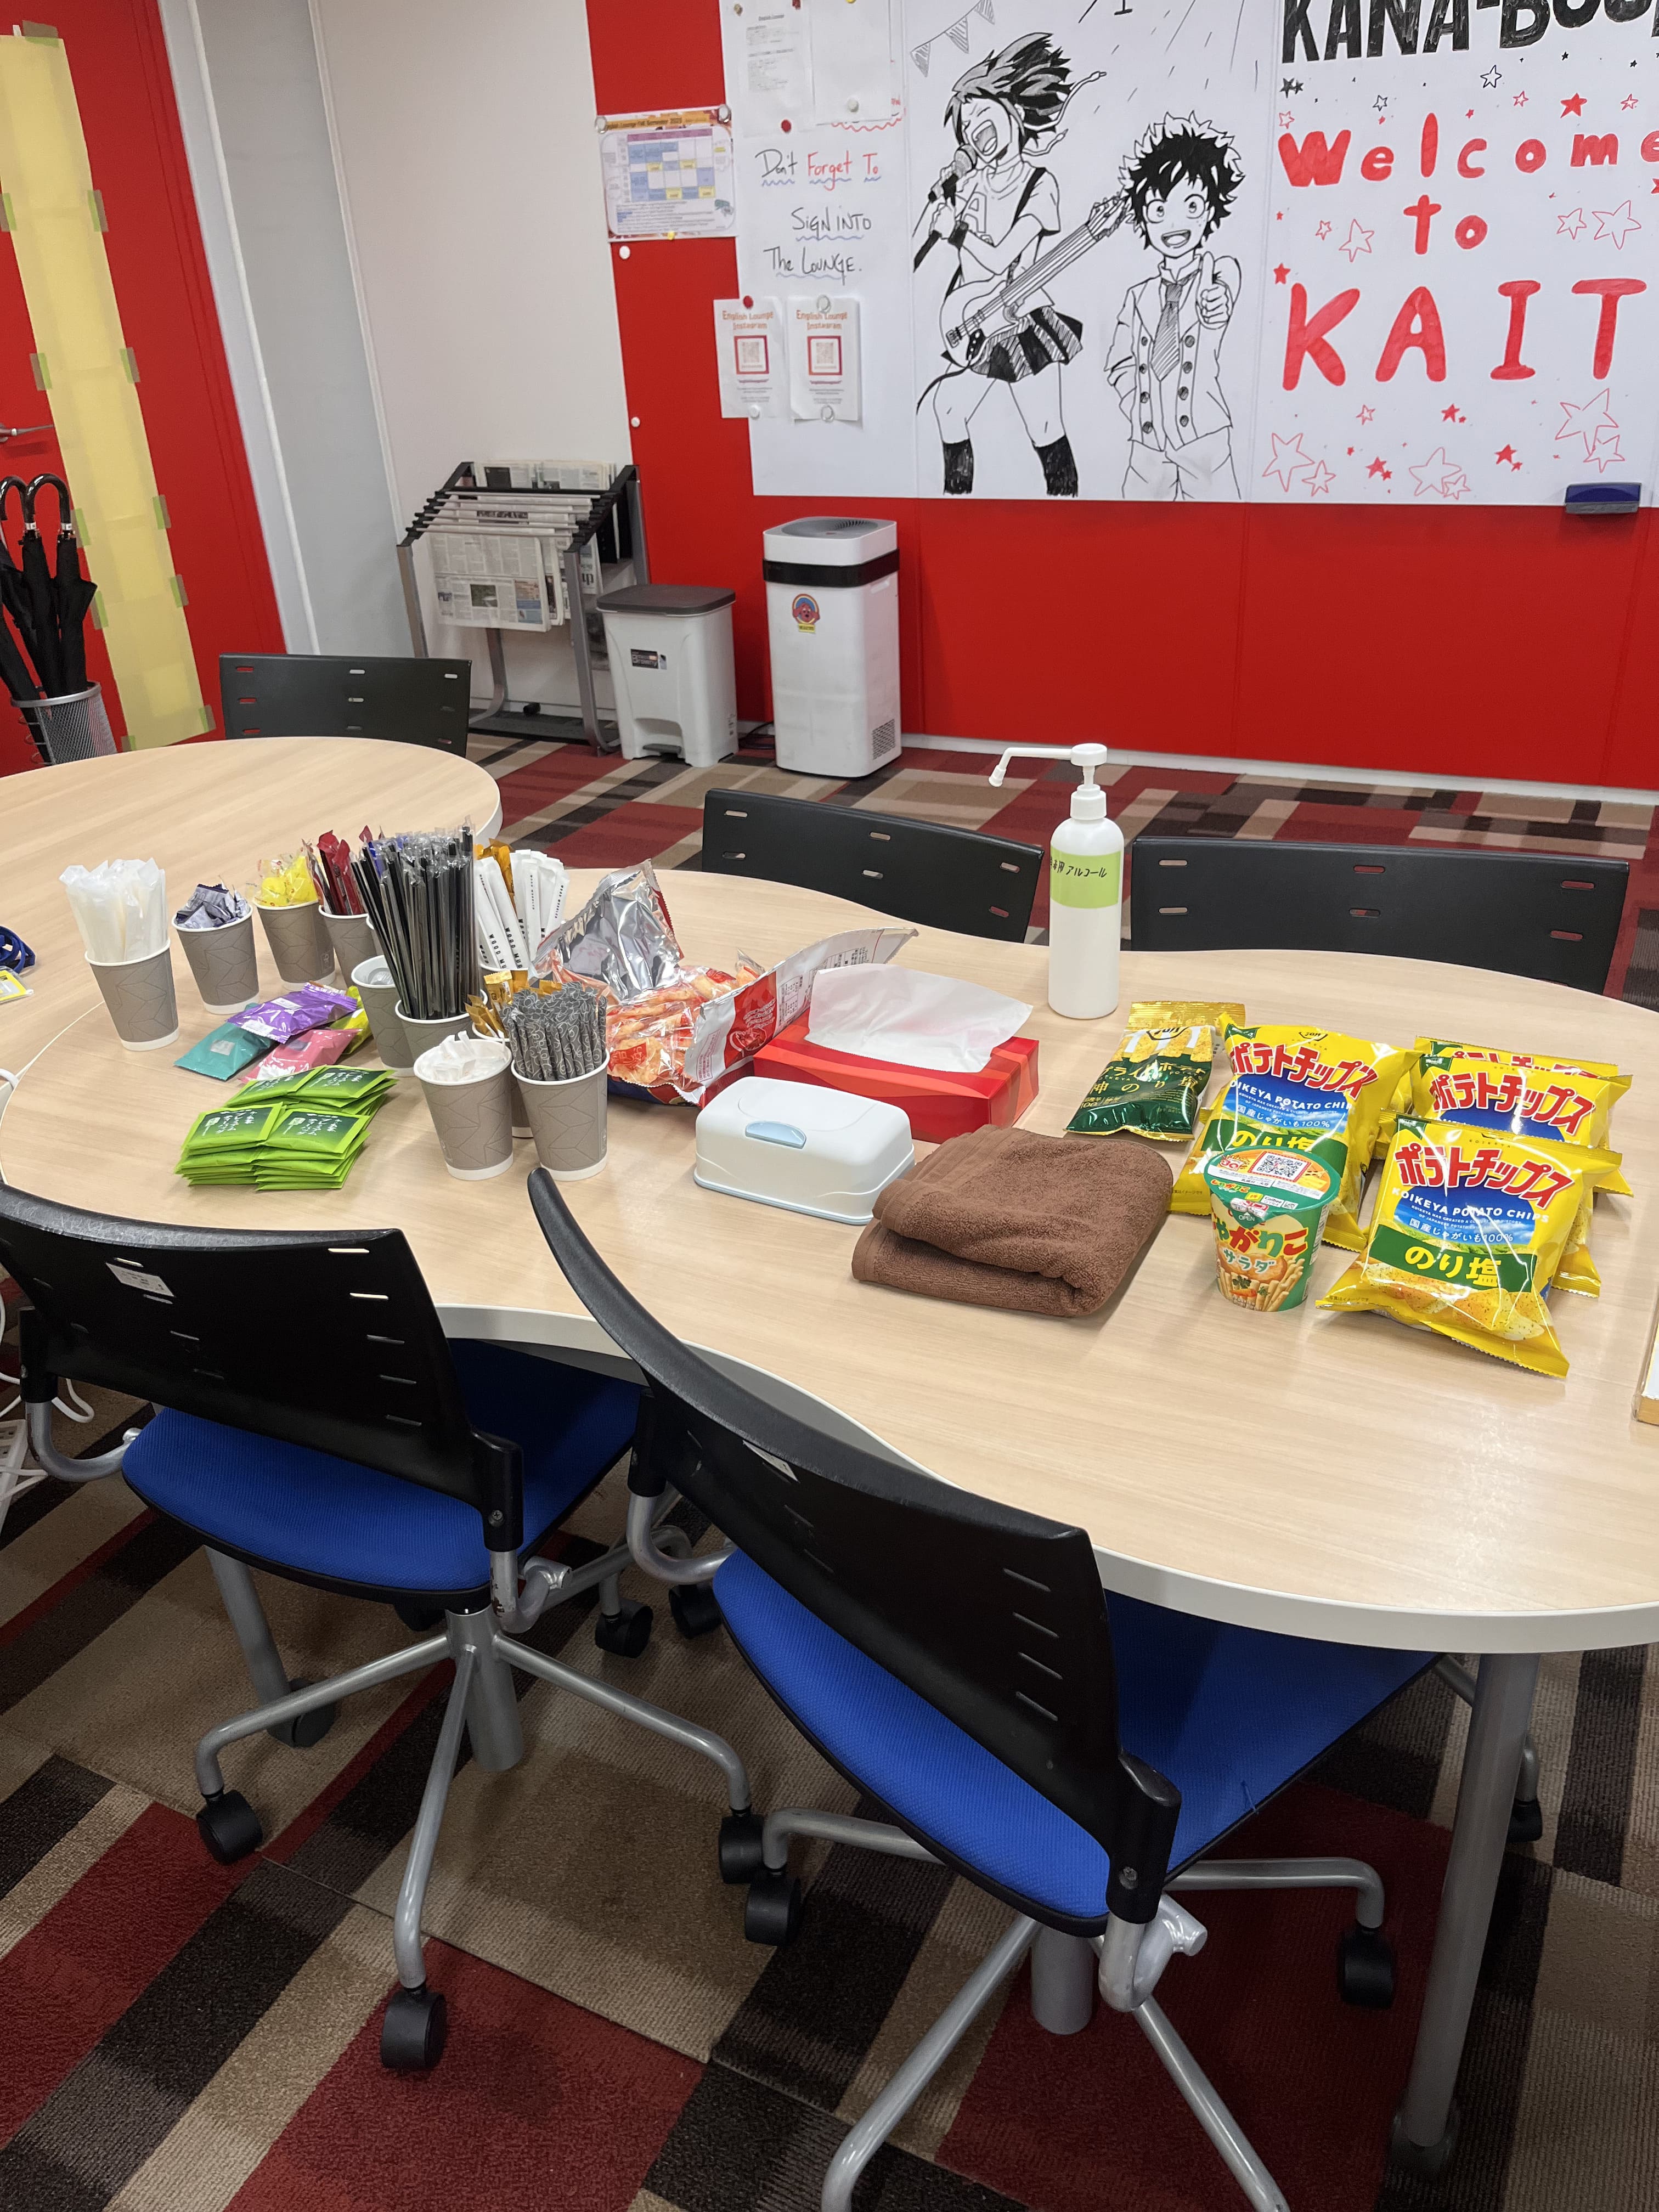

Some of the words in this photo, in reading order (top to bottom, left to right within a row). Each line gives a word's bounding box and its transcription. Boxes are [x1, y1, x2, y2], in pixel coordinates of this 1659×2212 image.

[755, 149, 798, 178] Don't
[808, 150, 853, 191] Forget
[862, 153, 879, 174] To
[1403, 195, 1488, 254] to
[763, 246, 794, 270] The
[723, 310, 748, 320] English
[749, 311, 774, 320] Lounge
[796, 309, 823, 320] English
[824, 311, 848, 320] Lounge
[1282, 278, 1647, 391] KAIT
[489, 934, 501, 955] WOOD
[505, 927, 516, 949] WOOD
[1229, 1042, 1378, 1101] ポテトチップス
[1229, 1080, 1271, 1101] OIKEYA
[1275, 1096, 1321, 1110] POTATO
[1324, 1101, 1352, 1110] CHIP
[1429, 1071, 1595, 1135] ポテトチップス
[1238, 1104, 1330, 1128] 国産じゃがいも100%
[1210, 1179, 1250, 1193] じゃがりこ
[1395, 1143, 1575, 1210] ポテトチップス
[1391, 1187, 1448, 1215] KOIKEYA
[1506, 1210, 1550, 1223] CHIPS
[1213, 1216, 1308, 1258] ゃがりこ
[1223, 1248, 1276, 1273] サラダ
[1404, 1246, 1502, 1287] のり塩
